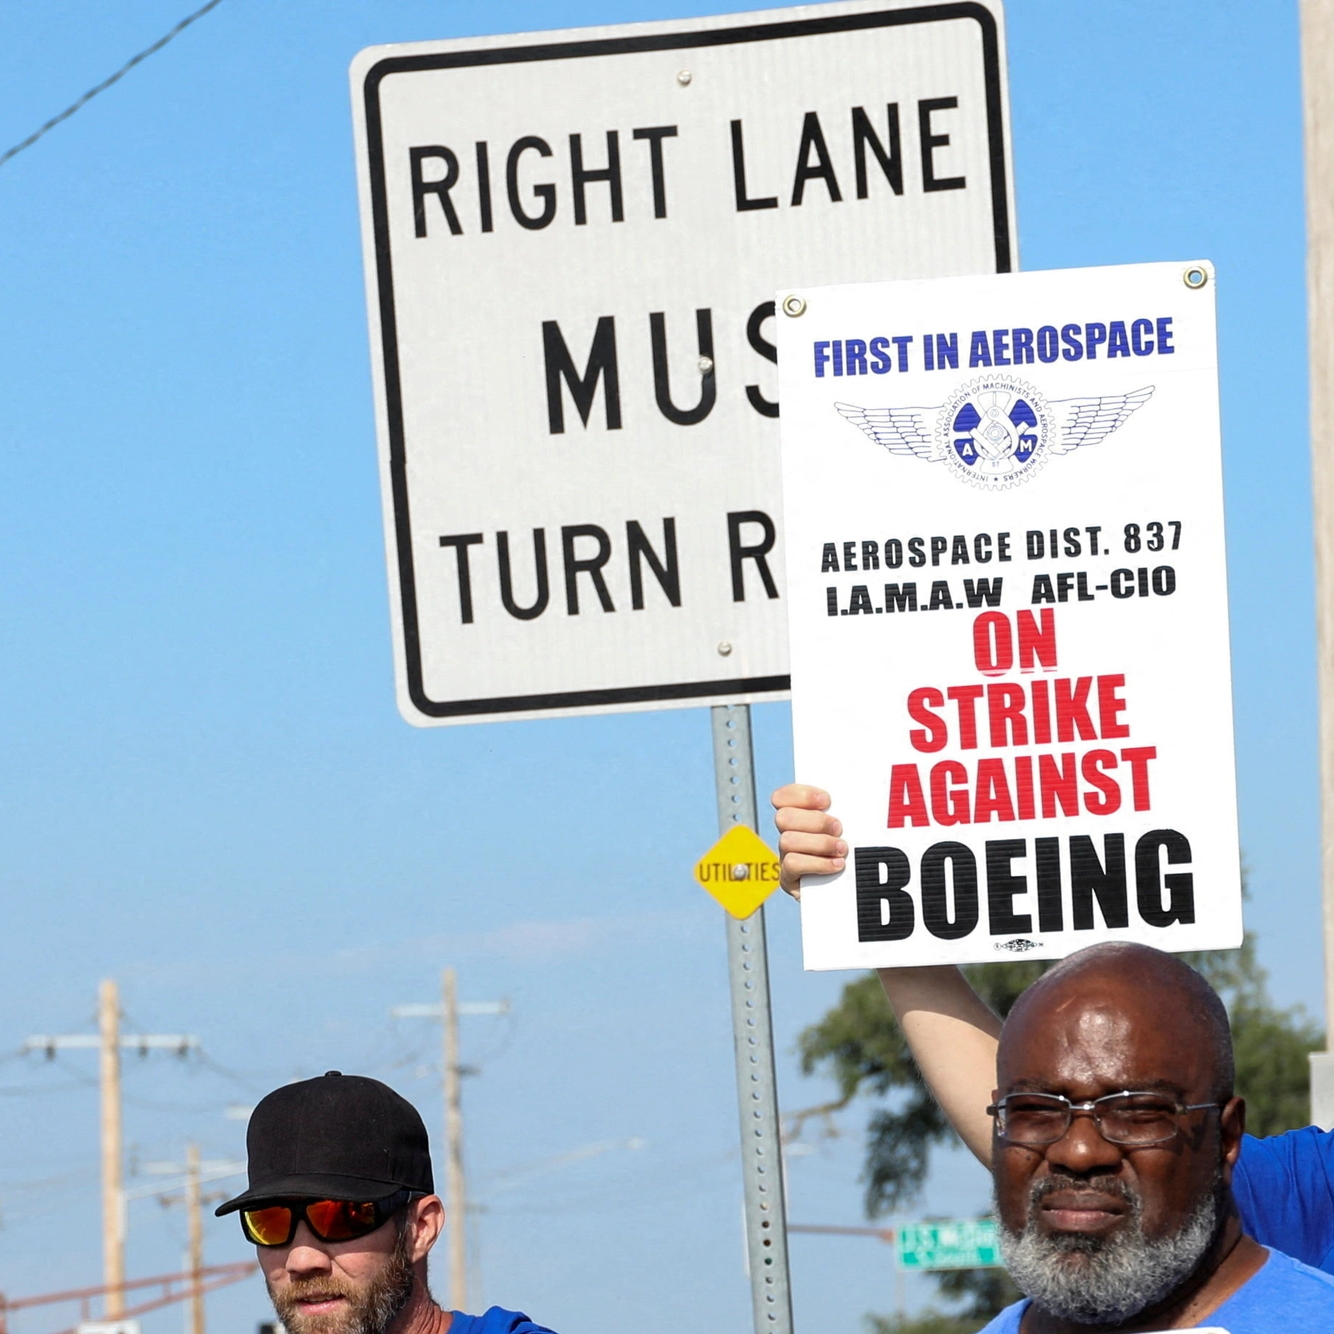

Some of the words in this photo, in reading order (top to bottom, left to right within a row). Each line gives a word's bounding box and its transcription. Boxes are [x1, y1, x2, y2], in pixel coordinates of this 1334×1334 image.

[409, 126, 678, 239] RIGHT
[730, 96, 968, 212] LANE
[541, 300, 780, 435] MUS
[813, 335, 913, 378] FIRST
[923, 332, 959, 371] IN
[969, 317, 1175, 368] AEROSPACE
[943, 392, 971, 437] ASSOCIATION
[971, 385, 981, 393] OF
[983, 382, 1030, 399] MACHINISTS
[1029, 397, 1043, 412] AND
[1034, 414, 1048, 458] AEROSPACE
[1003, 458, 1037, 482] WORKERS
[439, 516, 682, 625] TURN
[821, 533, 1012, 573] AEROSPACE
[1026, 526, 1110, 560] DIST.
[1123, 520, 1182, 554] 837
[826, 577, 1004, 617] I.A.M.A.W
[1031, 565, 1176, 605] AFL-CIO
[973, 607, 1059, 678] ON
[907, 673, 1130, 754] STRIKE
[887, 746, 1157, 829] AGAINST
[699, 863, 781, 882] UTILTIES
[854, 828, 1196, 943] BOEING
